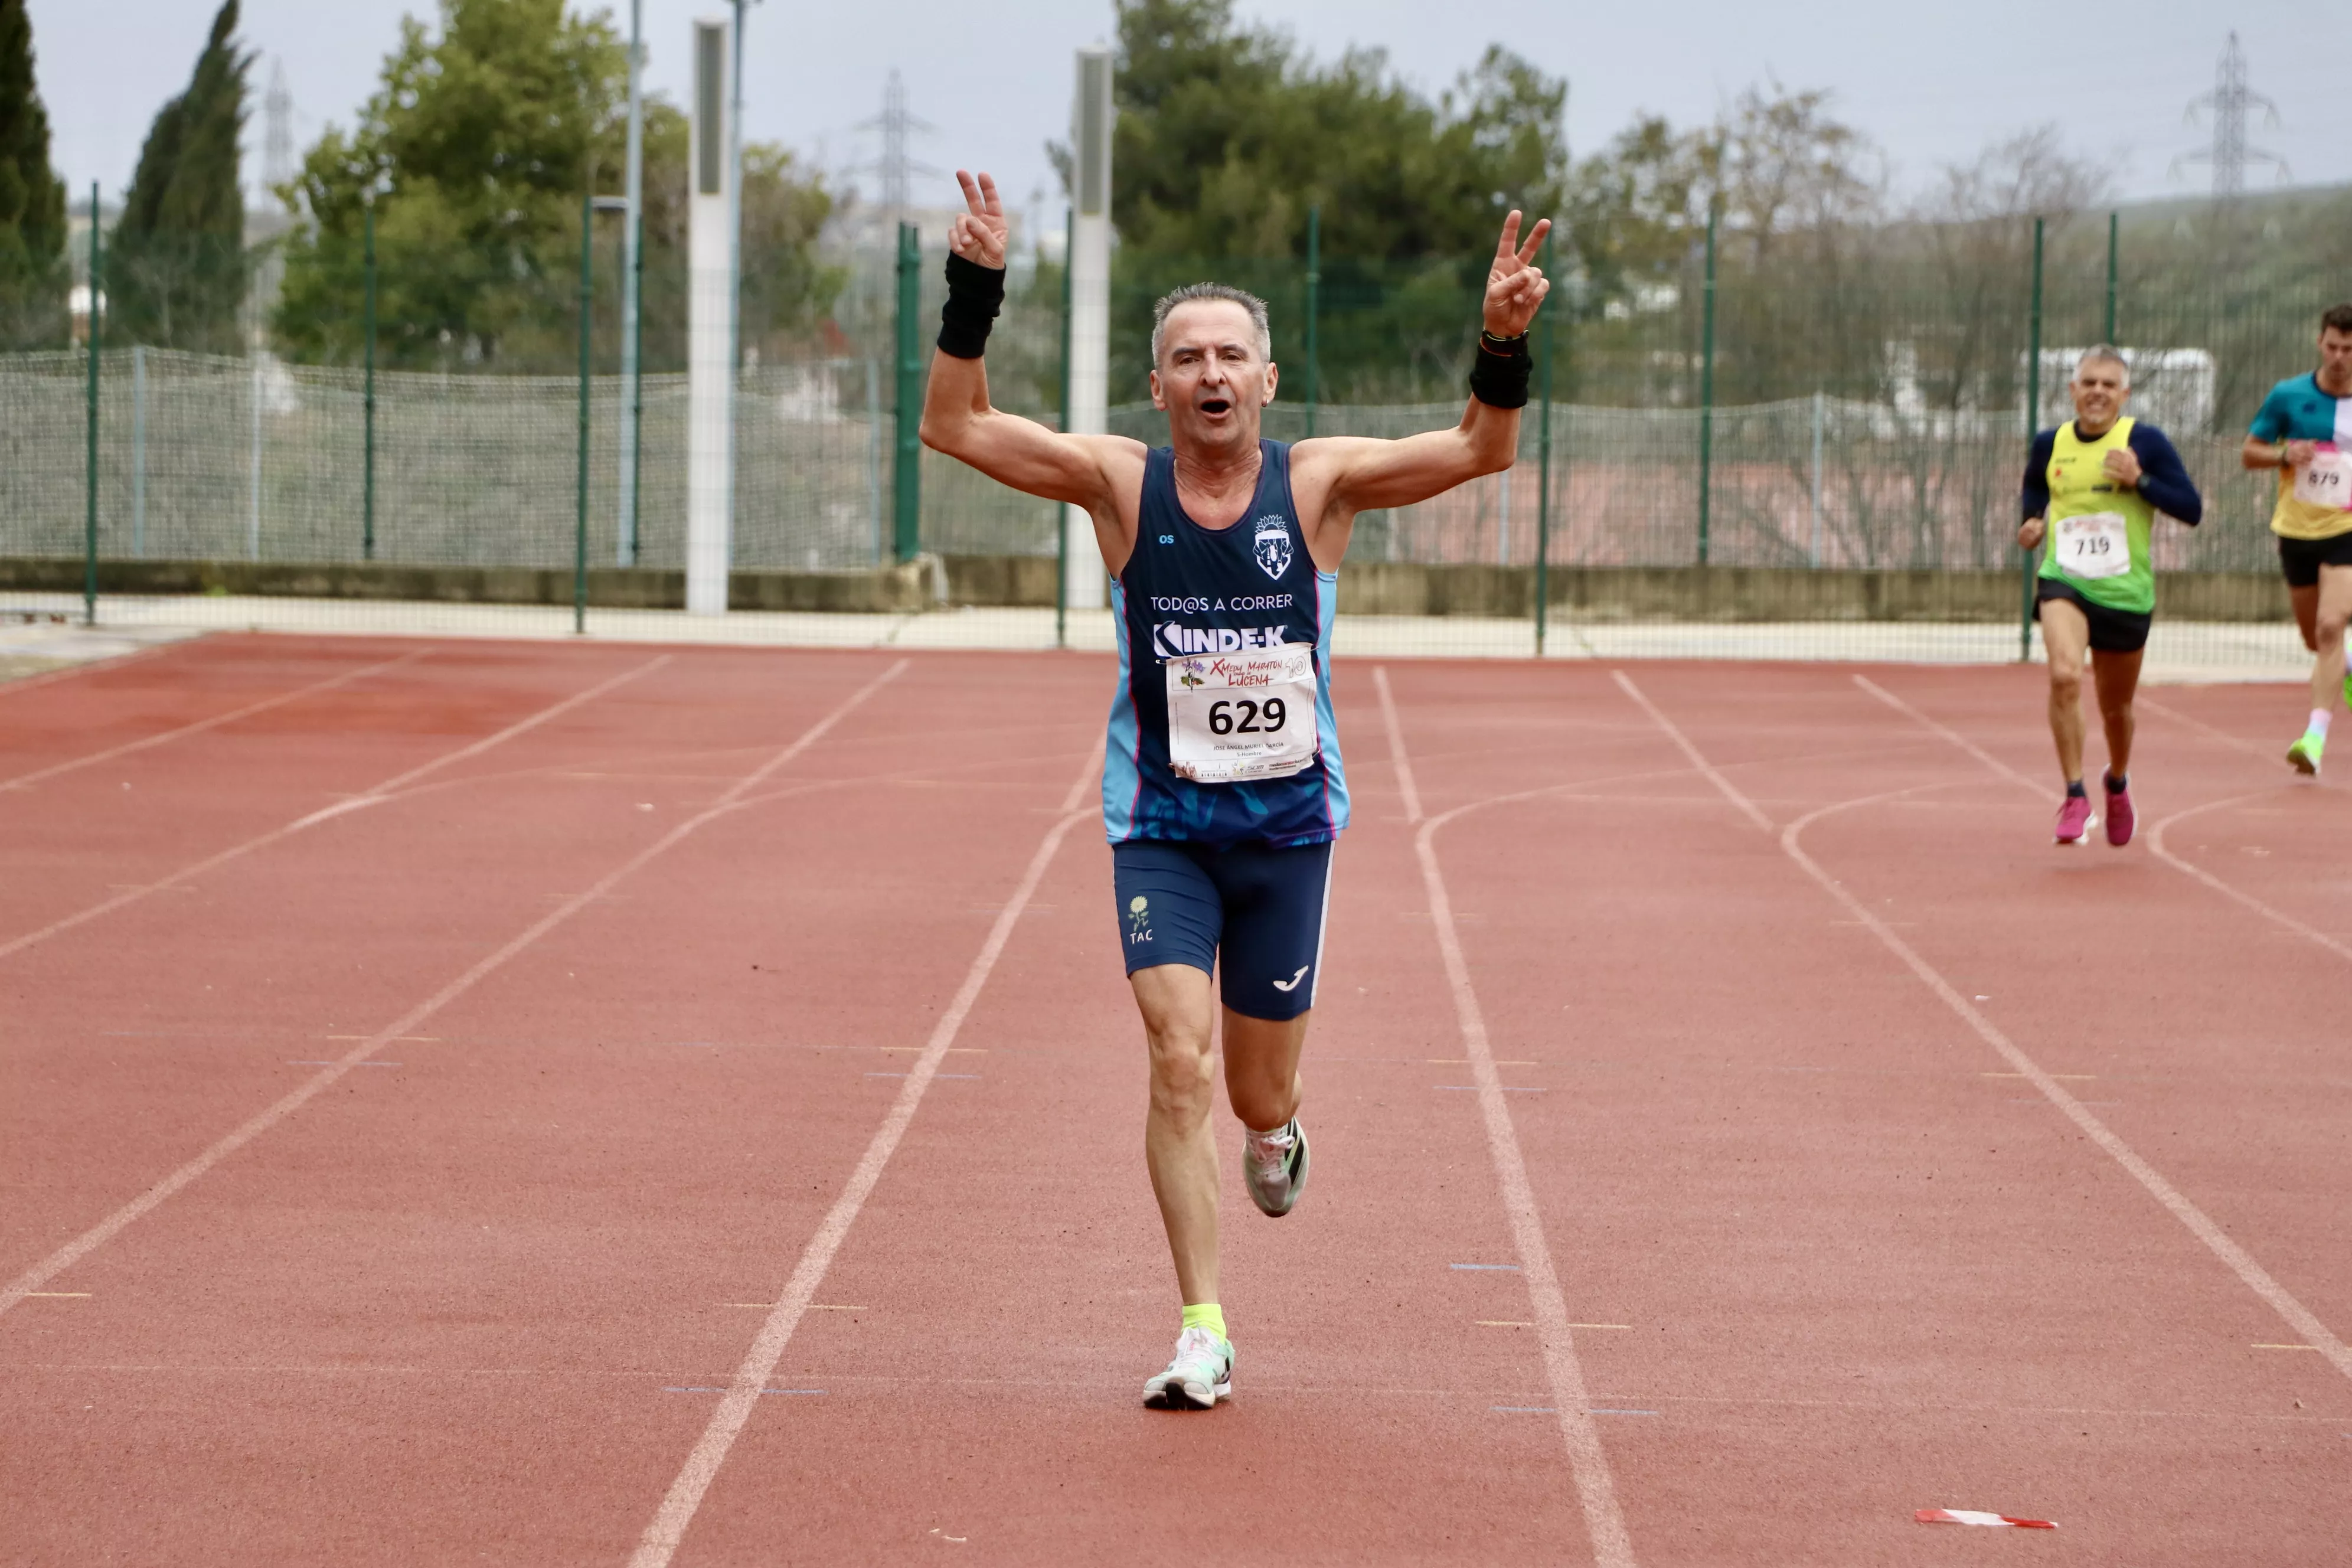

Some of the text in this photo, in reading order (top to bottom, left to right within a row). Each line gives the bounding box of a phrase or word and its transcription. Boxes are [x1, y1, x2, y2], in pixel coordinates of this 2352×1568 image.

[1159, 534, 1174, 544] OS
[2076, 536, 2110, 556] 719
[1151, 594, 1293, 614] TOD@S A CORRER
[1228, 674, 1272, 687] LUCENA
[1209, 698, 1286, 735] 629
[1130, 929, 1153, 945] TAC
